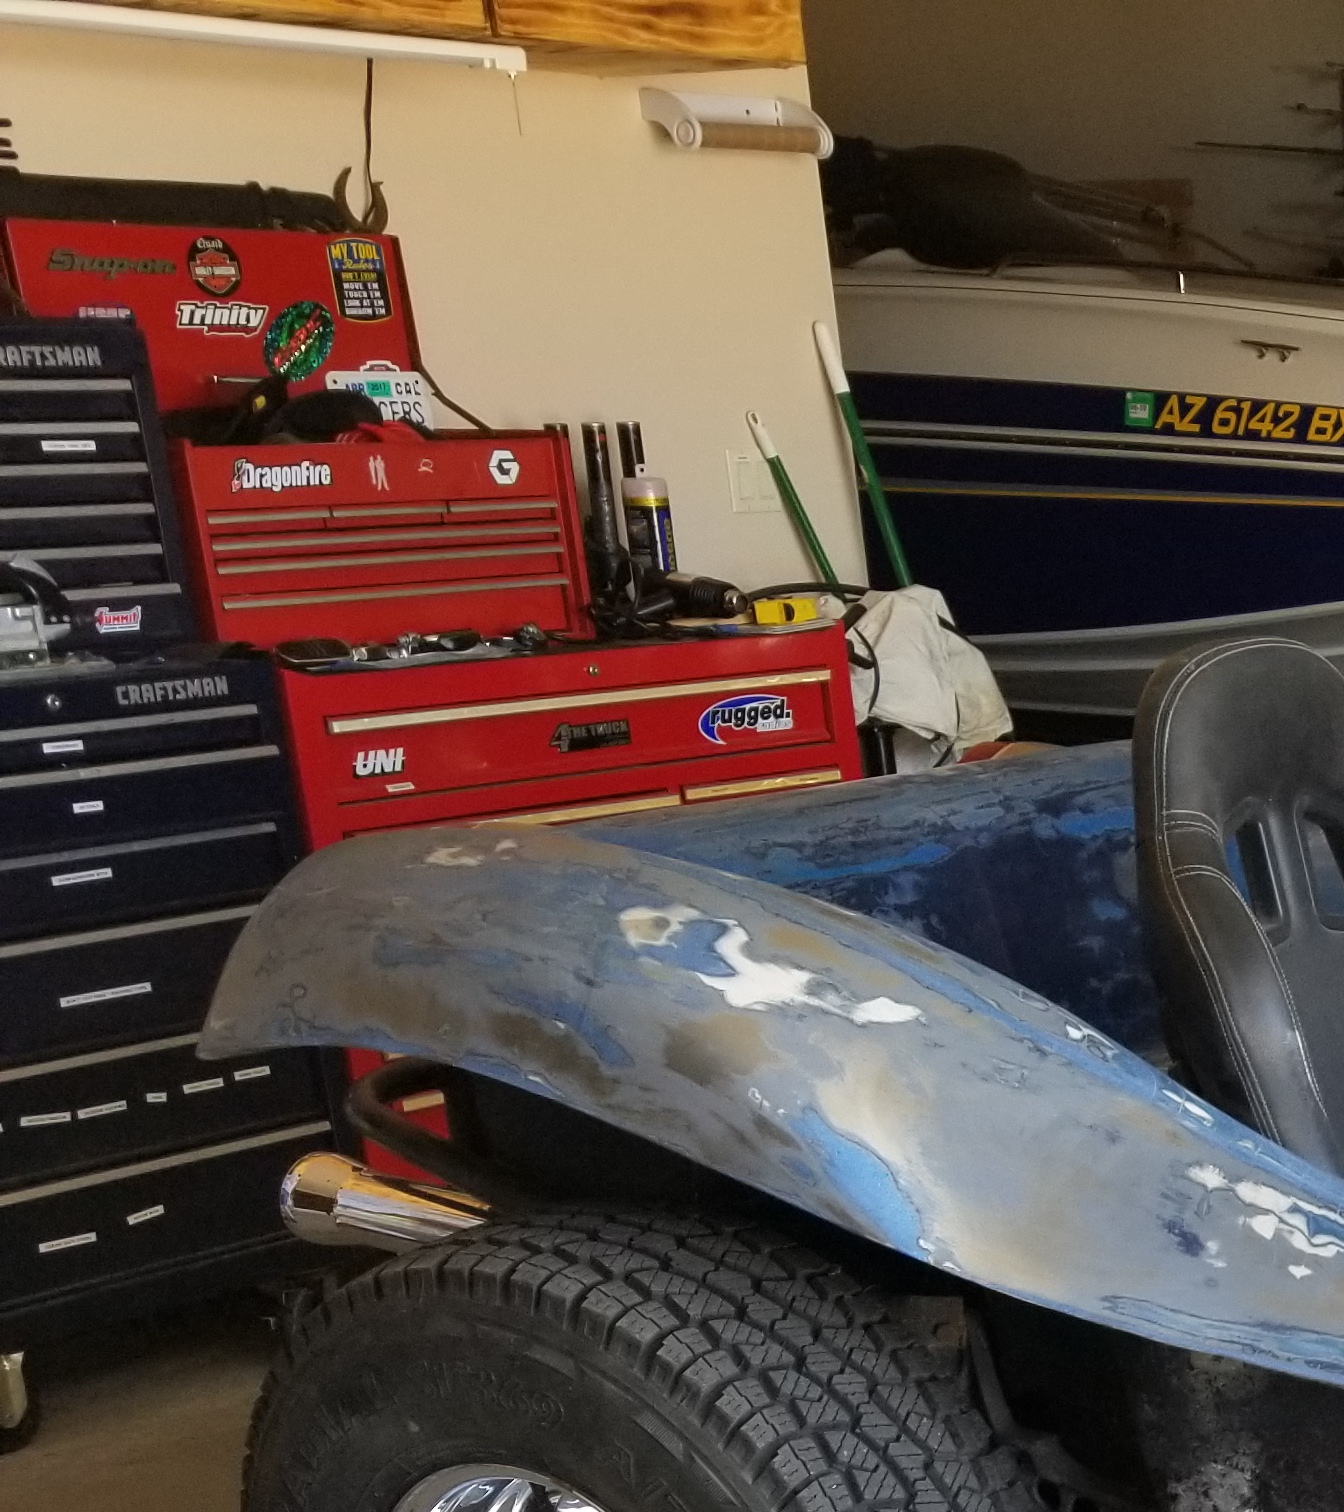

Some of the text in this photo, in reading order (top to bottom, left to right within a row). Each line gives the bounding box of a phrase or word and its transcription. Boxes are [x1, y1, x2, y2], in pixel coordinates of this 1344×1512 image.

[47, 248, 177, 280] Snap-on
[330, 242, 381, 260] MY TOOL
[179, 303, 266, 328] Trinity
[394, 382, 422, 396] CAL
[1154, 393, 1208, 433] AZ
[1211, 398, 1301, 439] 6142
[242, 459, 332, 491] DragonFire
[115, 675, 230, 706] CRAFTSMAN
[354, 747, 405, 776] UNI
